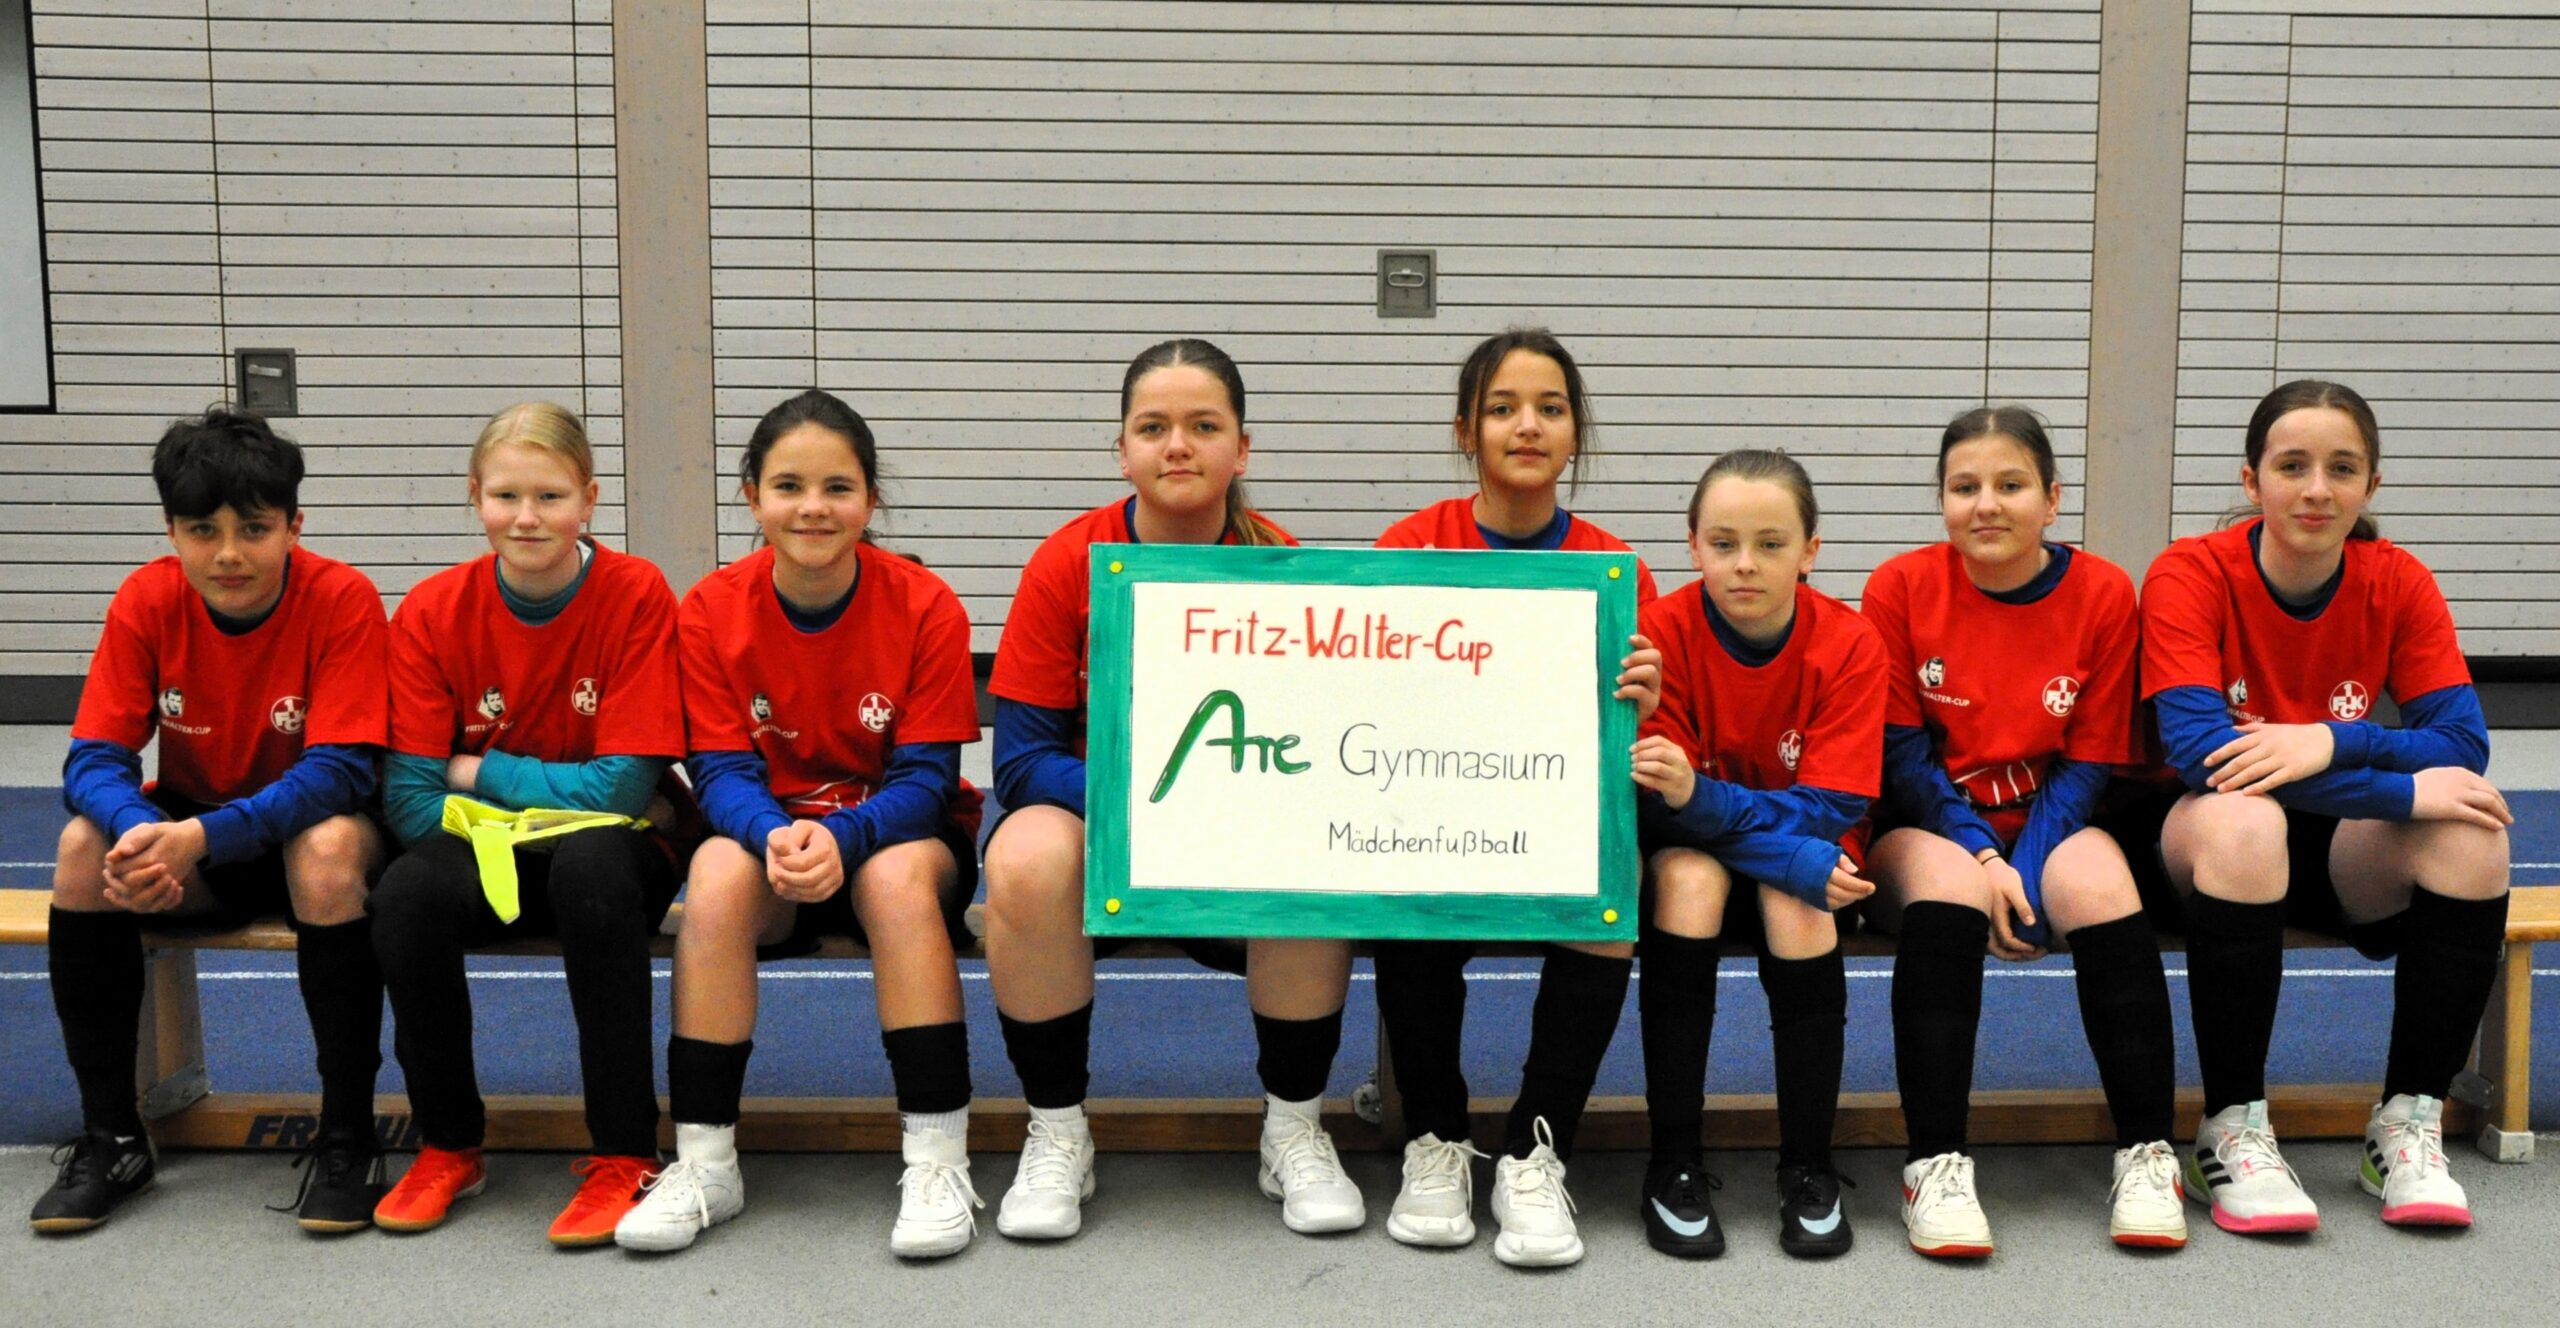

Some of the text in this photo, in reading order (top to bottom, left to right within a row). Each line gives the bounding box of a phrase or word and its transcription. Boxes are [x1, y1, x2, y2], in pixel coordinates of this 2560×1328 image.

[1185, 606, 1492, 675] Fritz-Walter-Cup
[1149, 689, 1564, 803] Are Gymnasium
[1330, 822, 1528, 857] Mädchenfußball
